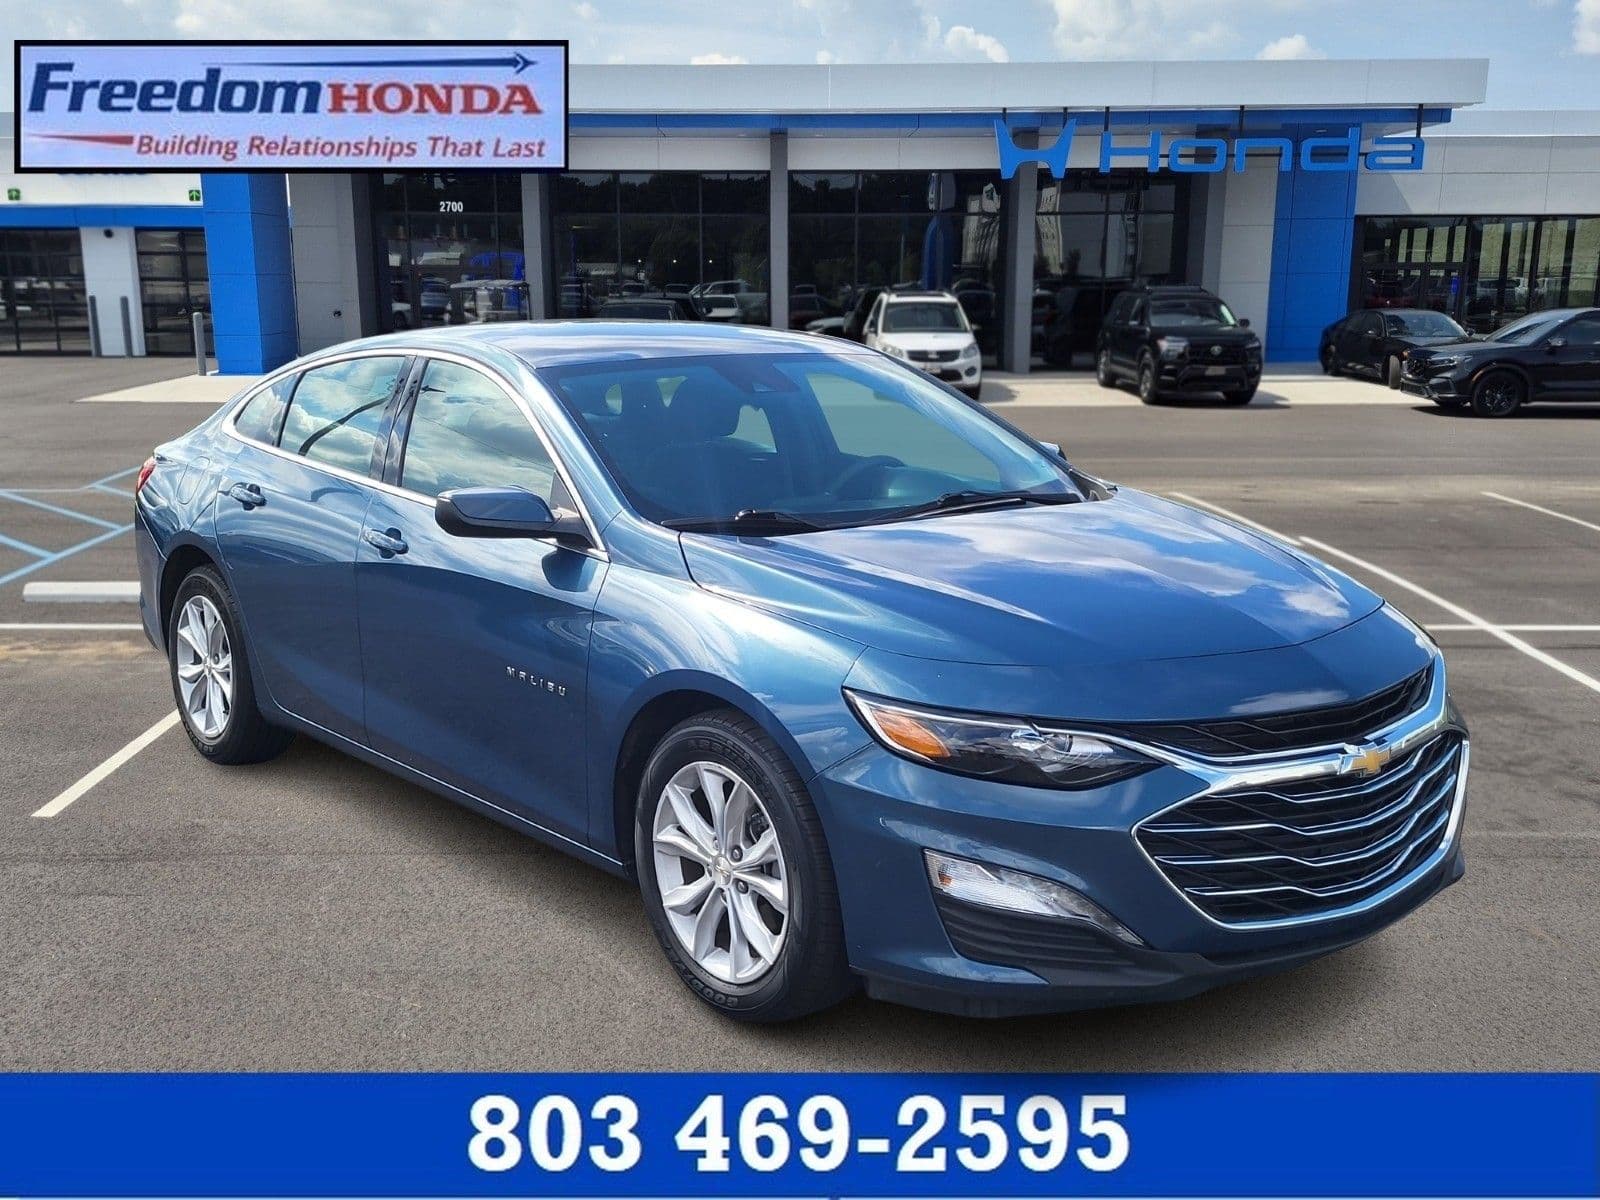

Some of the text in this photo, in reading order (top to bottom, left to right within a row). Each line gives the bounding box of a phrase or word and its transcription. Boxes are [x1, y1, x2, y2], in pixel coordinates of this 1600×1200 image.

[1099, 127, 1425, 173] Honda
[439, 201, 464, 213] 2700
[506, 666, 566, 697] MALIBU
